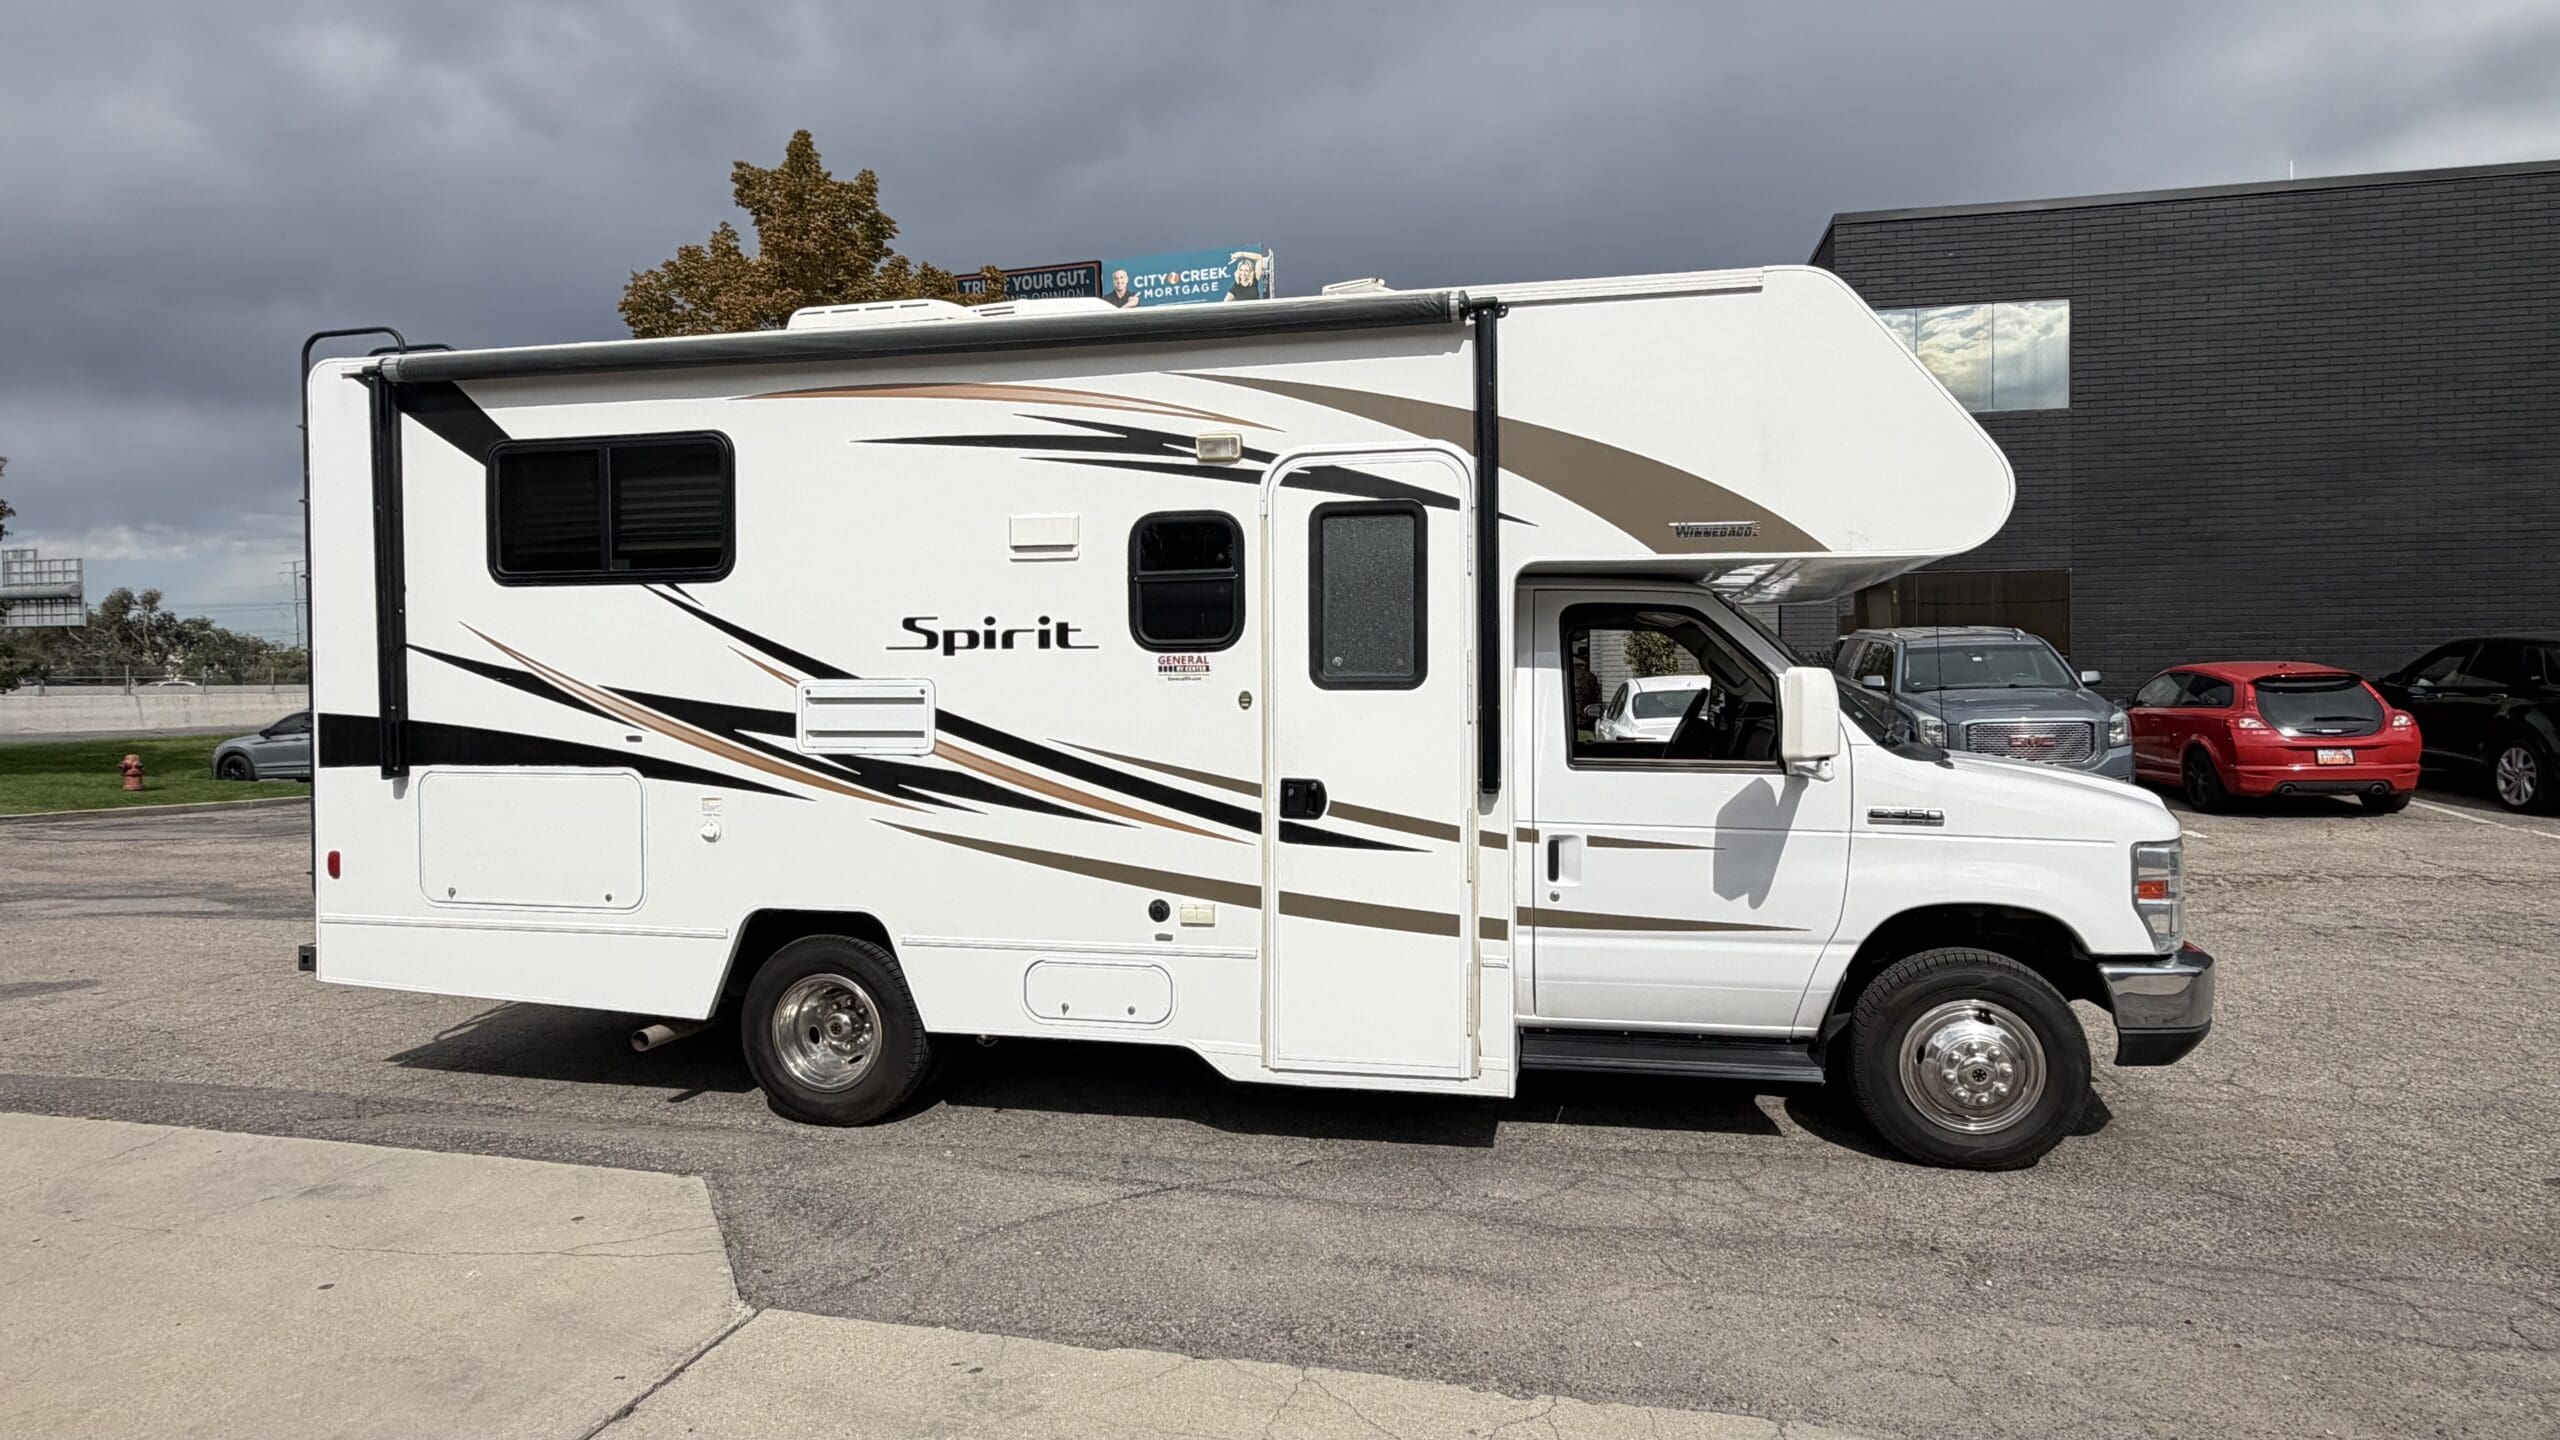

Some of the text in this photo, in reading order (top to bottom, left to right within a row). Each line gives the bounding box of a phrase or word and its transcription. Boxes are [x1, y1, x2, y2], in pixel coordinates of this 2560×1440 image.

[1012, 274, 1054, 291] YOUR
[1057, 269, 1090, 286] GUT.
[1134, 273, 1167, 288] CITY
[1144, 281, 1219, 299] MORTGAGE
[886, 616, 1099, 656] Spirit
[1158, 655, 1210, 665] GENERAL
